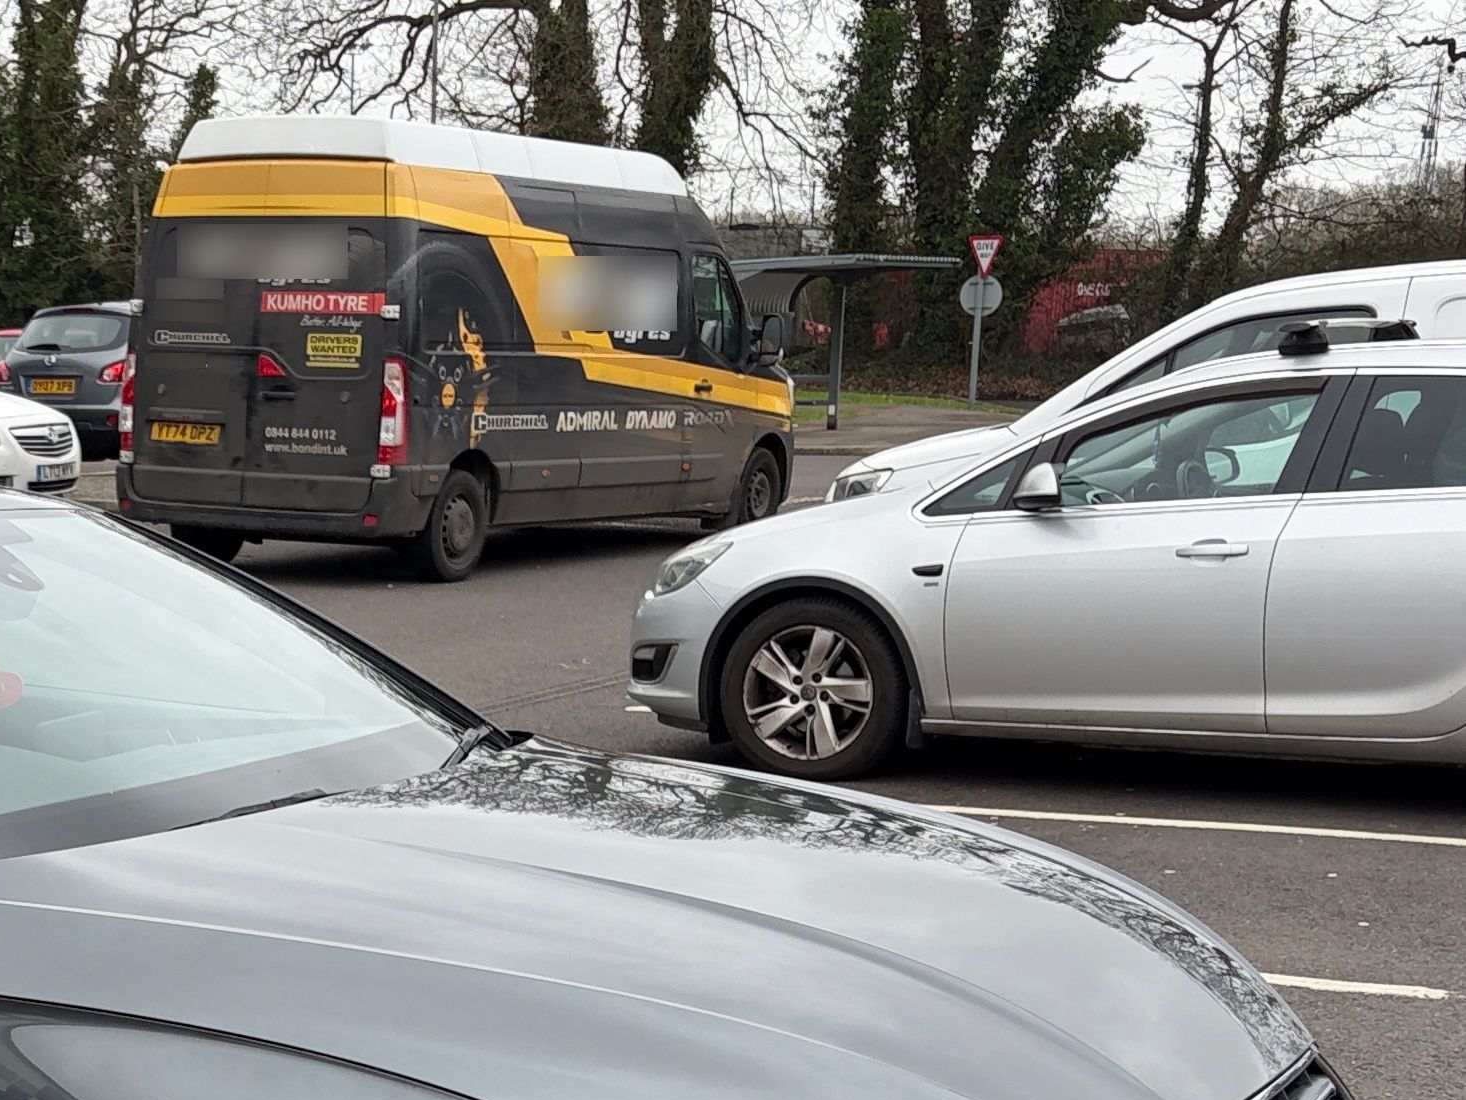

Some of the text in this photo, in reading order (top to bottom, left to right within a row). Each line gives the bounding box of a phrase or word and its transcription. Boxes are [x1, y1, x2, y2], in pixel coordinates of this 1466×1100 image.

[266, 294, 369, 313] KUMHO TYRE
[155, 331, 230, 344] CHURCHILL
[310, 335, 359, 345] DRIVERS
[310, 345, 358, 354] WANTED
[473, 411, 549, 433] CHURCHILL
[556, 410, 618, 432] ADMIRAL
[625, 409, 677, 430] DYNAMO
[265, 426, 337, 441] 0844 844 0112
